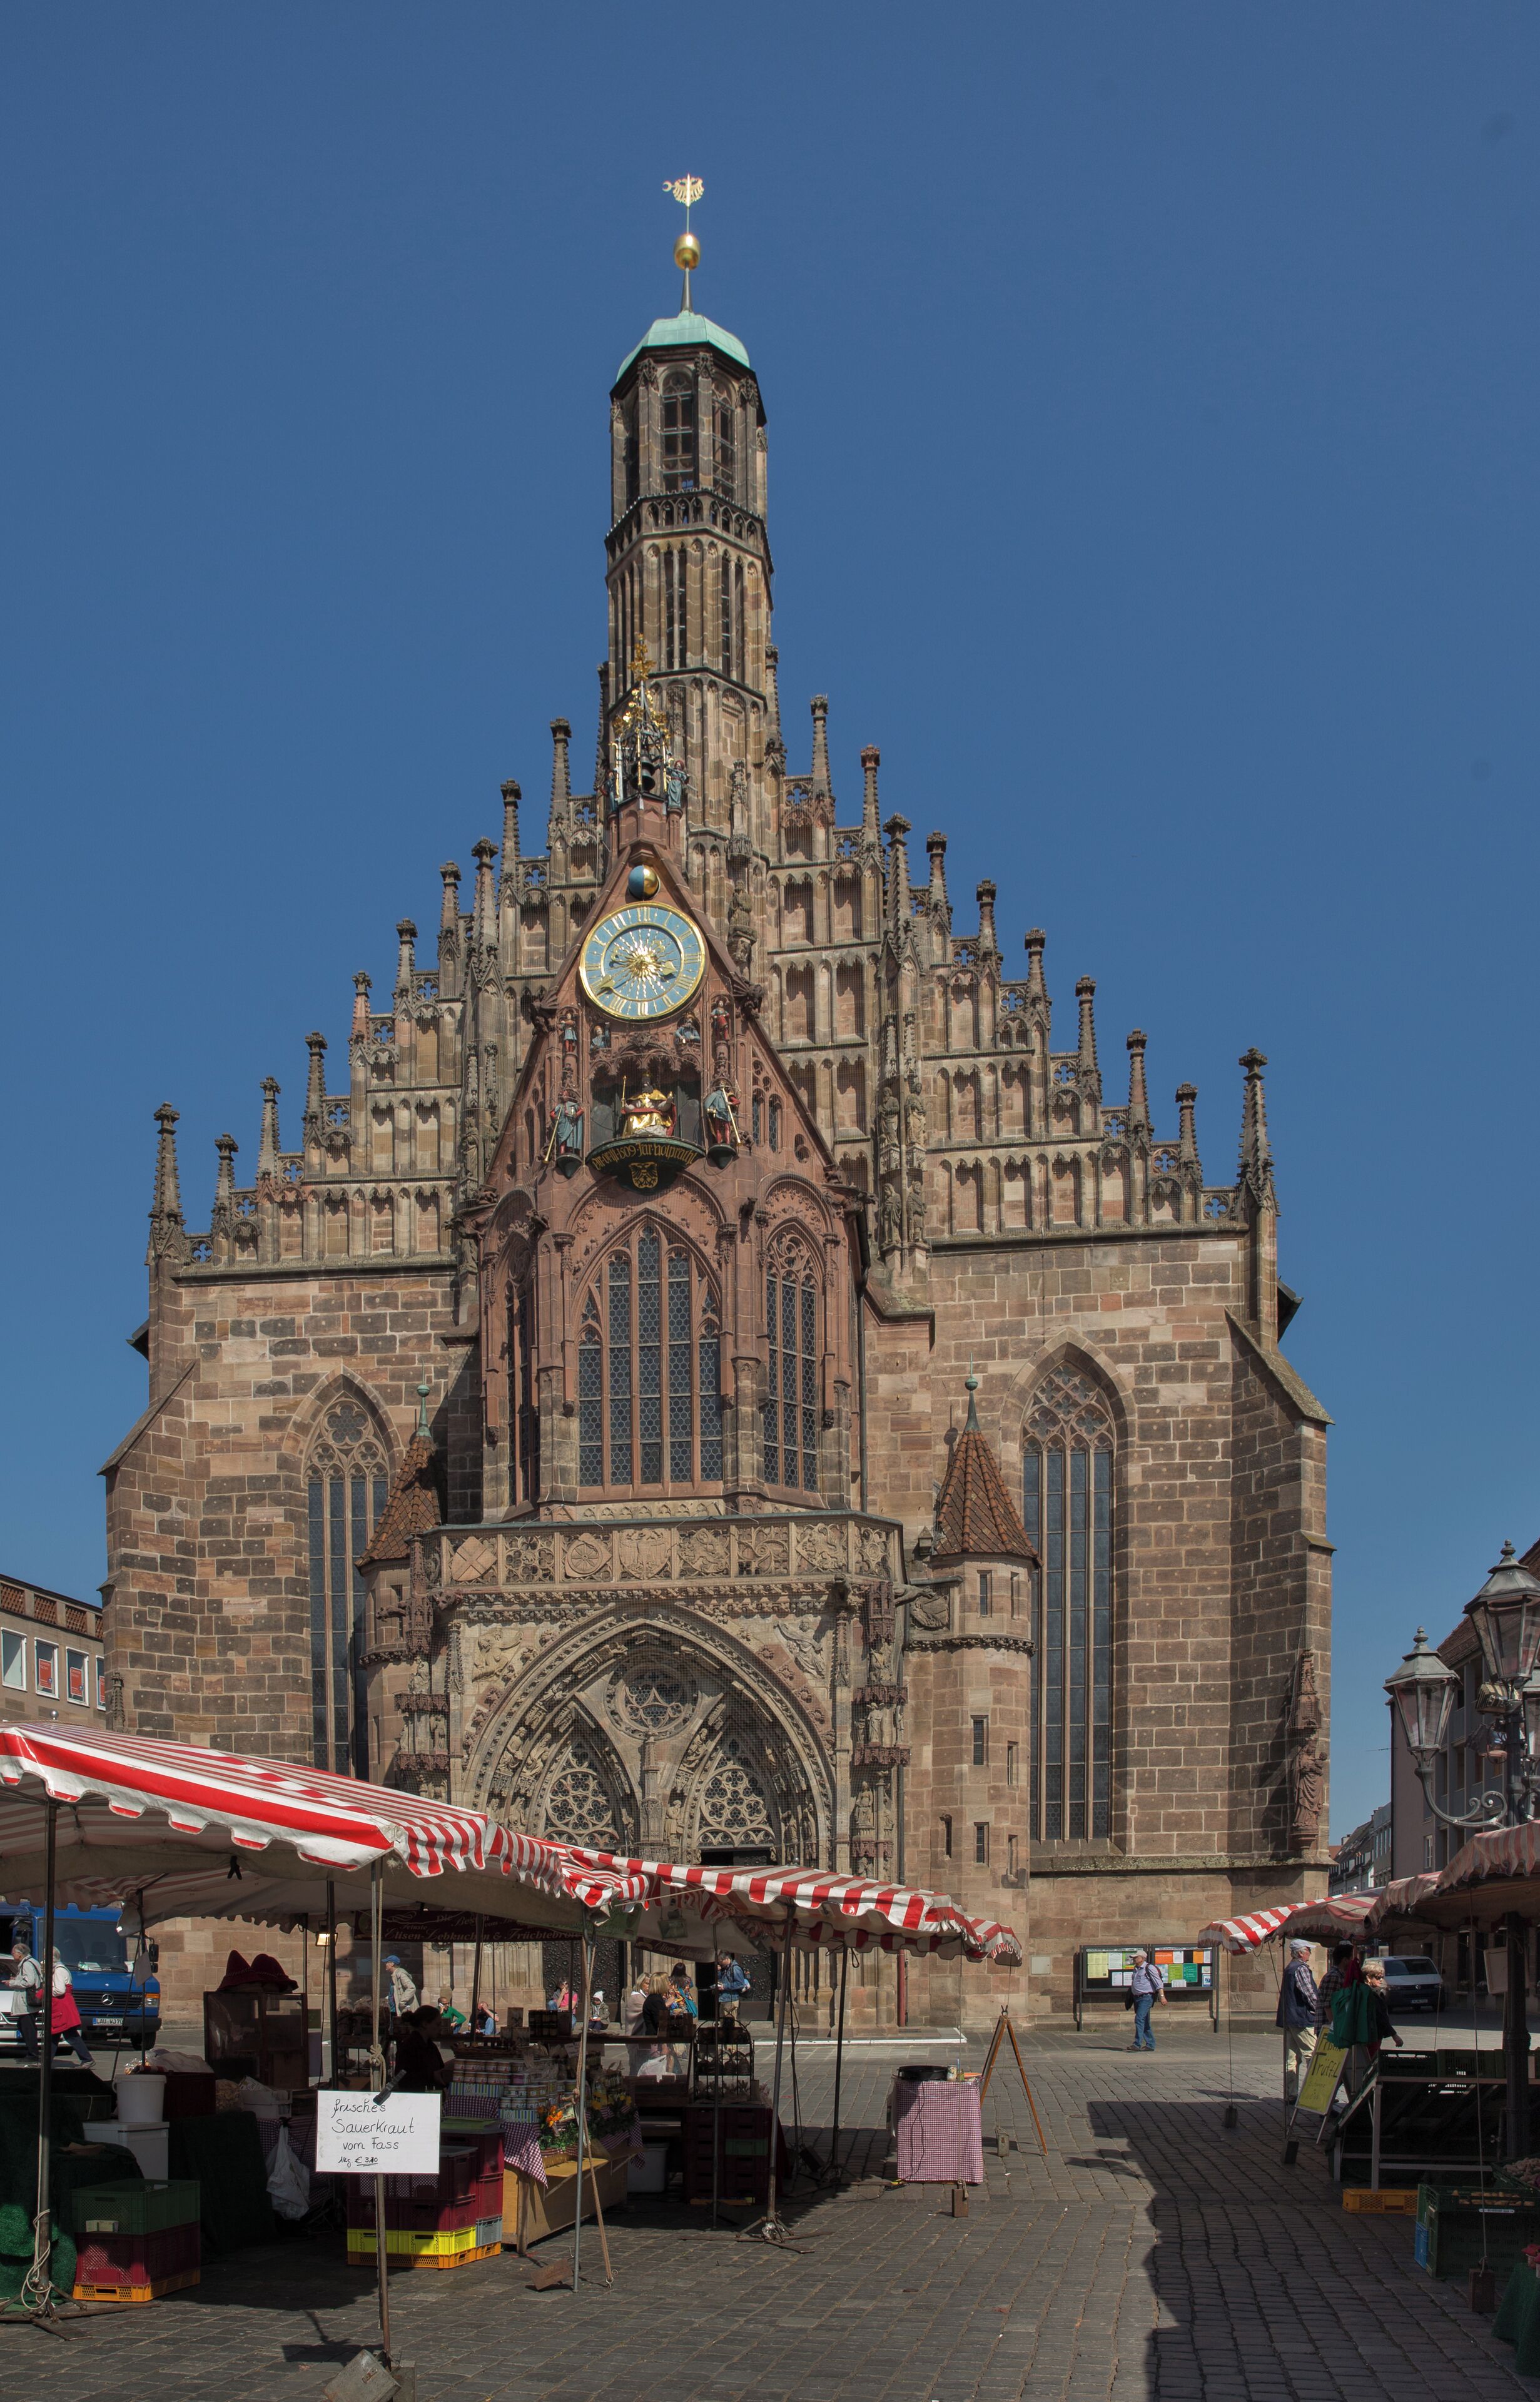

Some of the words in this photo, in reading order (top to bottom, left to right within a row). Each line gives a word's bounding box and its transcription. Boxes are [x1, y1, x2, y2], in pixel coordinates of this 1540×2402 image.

[331, 2098, 386, 2118] frisches
[343, 2142, 365, 2151] vom
[372, 2137, 399, 2150] Fass
